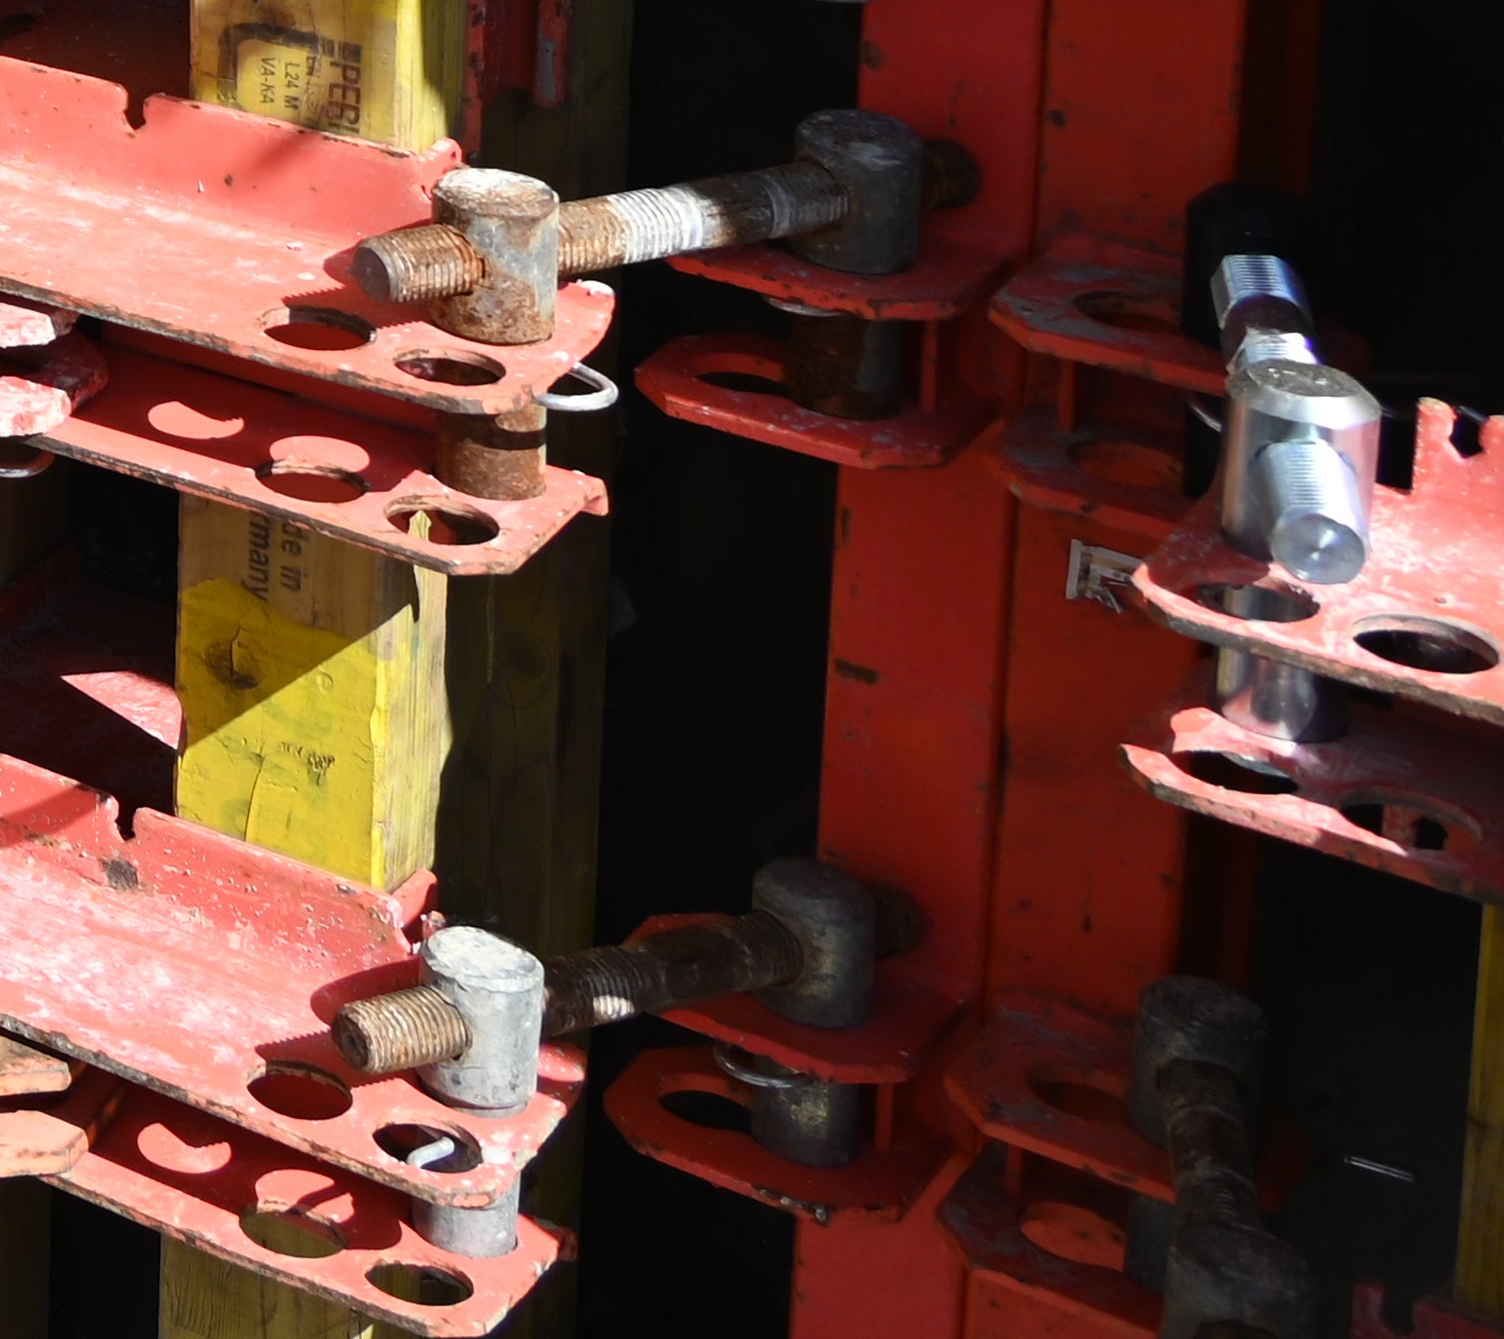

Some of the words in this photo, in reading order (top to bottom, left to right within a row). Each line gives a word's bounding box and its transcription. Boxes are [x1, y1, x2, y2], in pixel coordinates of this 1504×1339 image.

[259, 57, 276, 104] VA-KA
[284, 61, 300, 89] L24
[284, 94, 299, 111] M
[327, 61, 361, 134] PERI
[279, 565, 308, 593] in
